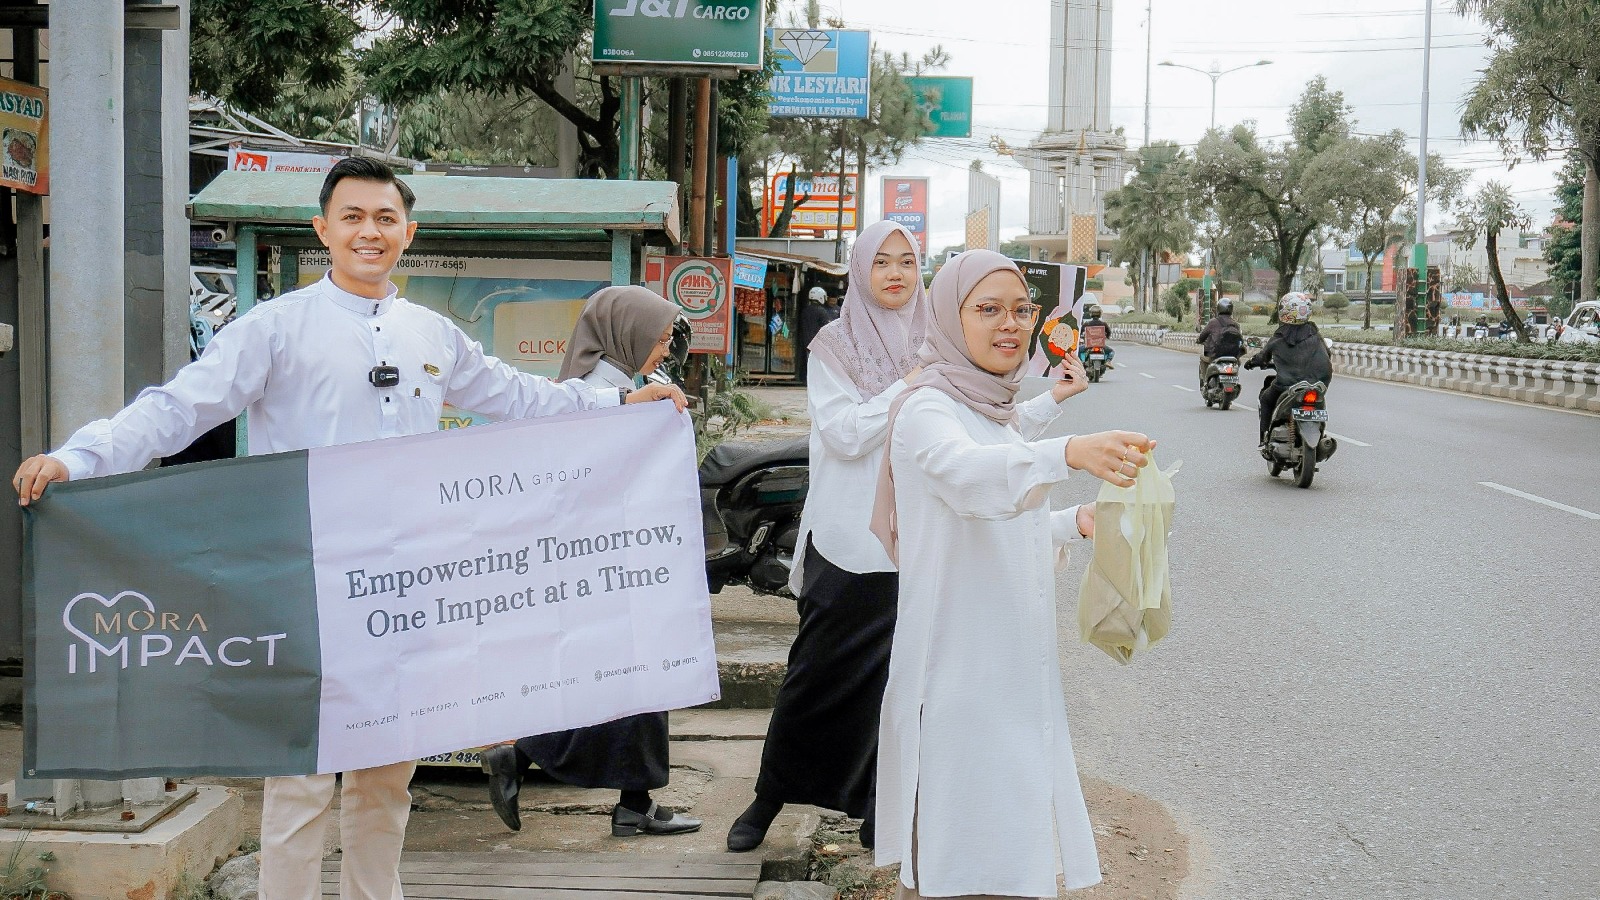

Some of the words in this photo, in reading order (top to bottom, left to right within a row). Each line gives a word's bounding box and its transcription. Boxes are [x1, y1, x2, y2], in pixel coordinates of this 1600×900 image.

[692, 5, 750, 20] CARGO
[768, 75, 791, 93] NK
[794, 76, 868, 94] LESTARI
[819, 106, 857, 116] LESTARI
[518, 340, 566, 354] CLICK
[439, 472, 524, 504] MORA
[532, 467, 592, 486] GROUP
[346, 546, 529, 599] Empowering
[537, 524, 682, 564] Tomorrow,
[366, 609, 426, 638] One
[435, 586, 535, 626] Impact
[544, 580, 568, 604] at
[576, 577, 592, 598] a
[598, 565, 670, 594] Time
[95, 610, 208, 635] MORA
[68, 632, 287, 674] IMPACT
[683, 656, 699, 665] HOTEL
[603, 668, 622, 679] GRAND
[633, 663, 650, 674] HOTEL
[471, 691, 506, 705] LAMORA
[410, 701, 459, 717] HEMORA
[345, 712, 399, 731] MORAZEN
